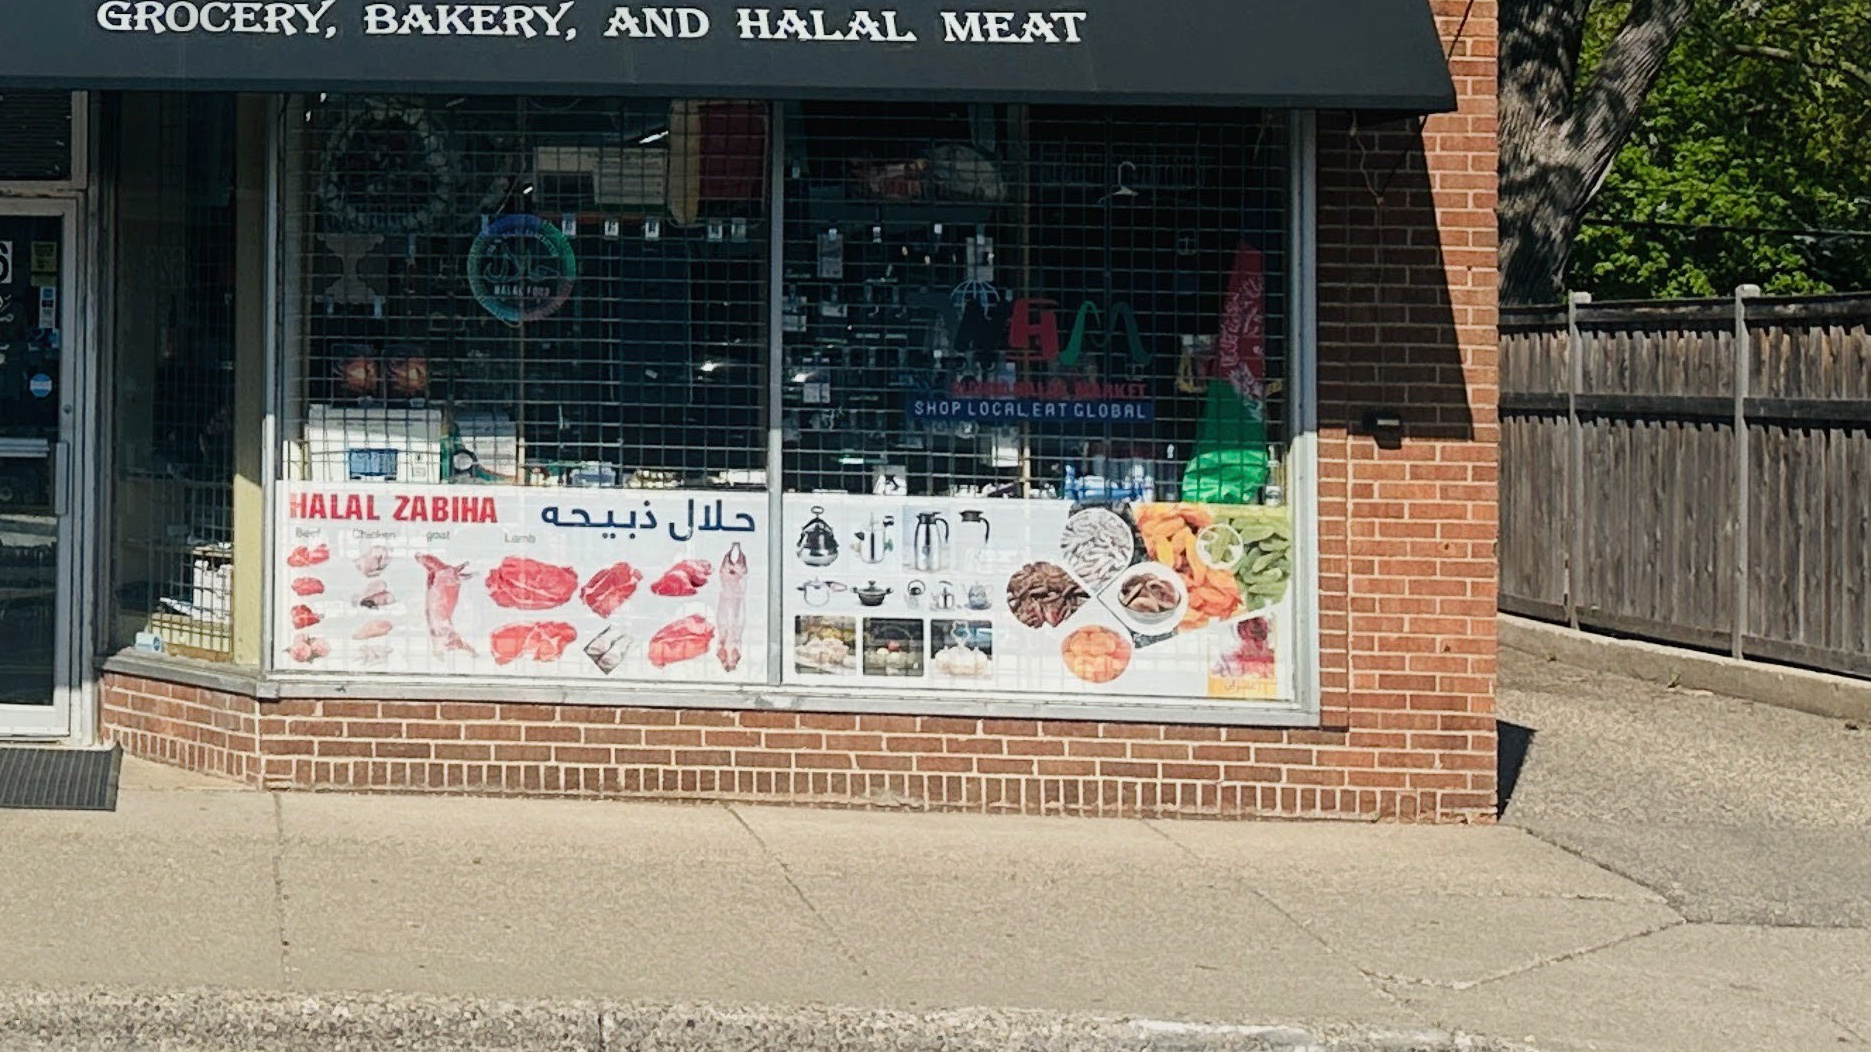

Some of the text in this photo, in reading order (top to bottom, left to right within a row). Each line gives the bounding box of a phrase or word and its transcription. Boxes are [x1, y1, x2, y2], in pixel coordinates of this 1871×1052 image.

[363, 0, 577, 41] BAKERY,
[603, 6, 710, 38] AND
[736, 8, 918, 42] HALAL
[940, 11, 1087, 43] MEAT
[914, 401, 961, 415] SHOP
[1032, 402, 1067, 417] EAT
[1073, 402, 1146, 419] GLOBAL
[289, 493, 498, 524] HALAL ZABIHA
[669, 499, 755, 542] حلال
[352, 528, 397, 540] Chicken
[504, 532, 536, 544] Lamb
